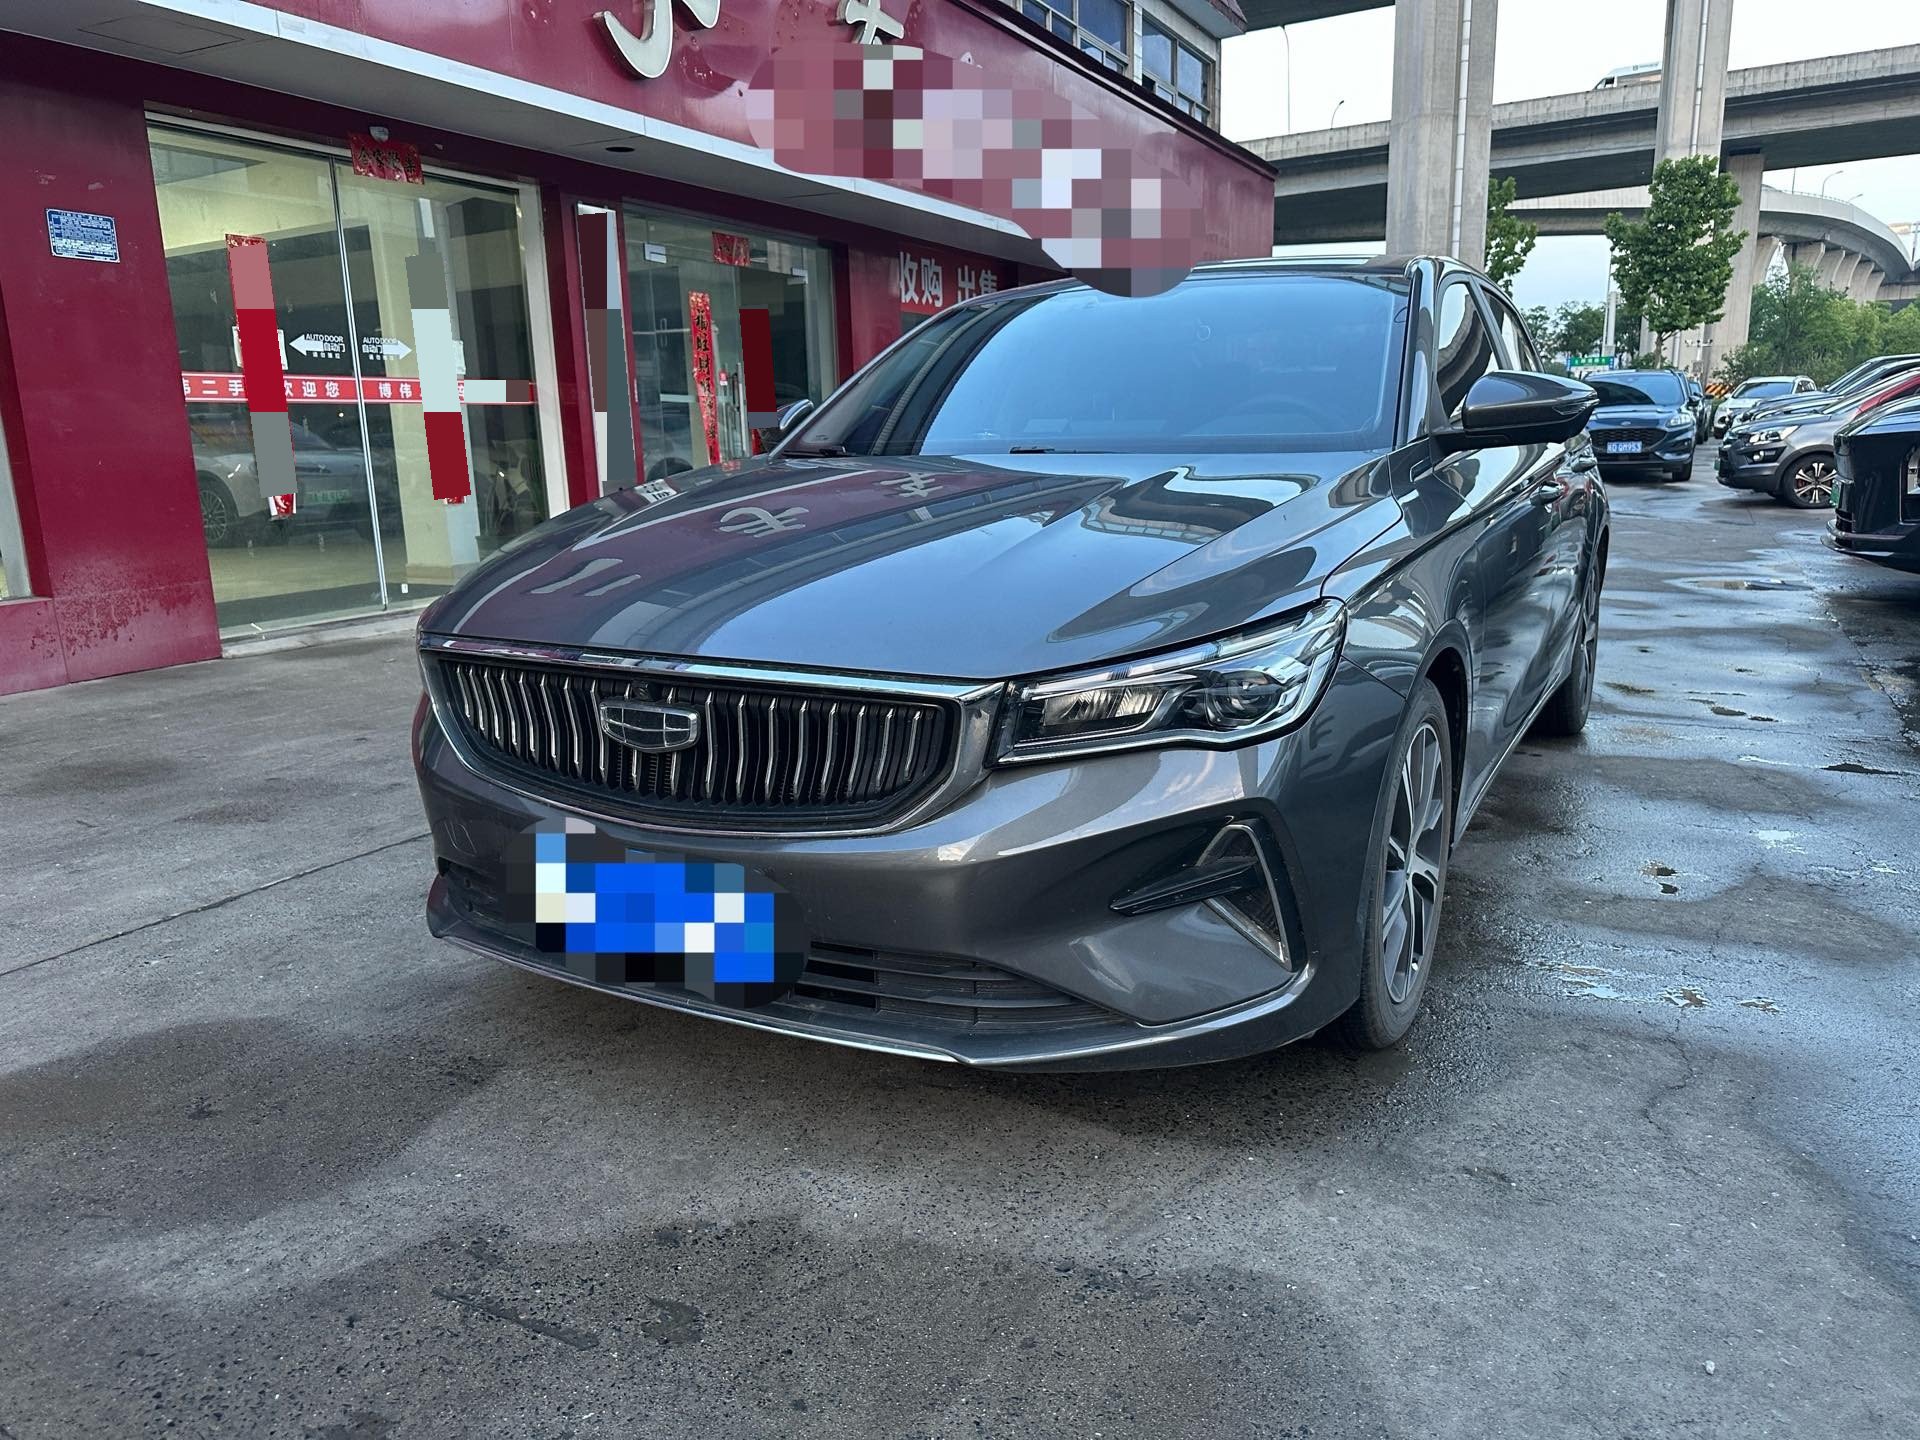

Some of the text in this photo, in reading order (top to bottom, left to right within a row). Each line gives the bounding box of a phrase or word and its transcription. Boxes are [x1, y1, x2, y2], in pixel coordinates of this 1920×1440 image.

[899, 251, 944, 308] 收购
[305, 333, 344, 344] AUTO DOOR
[362, 337, 380, 345] AUTO
